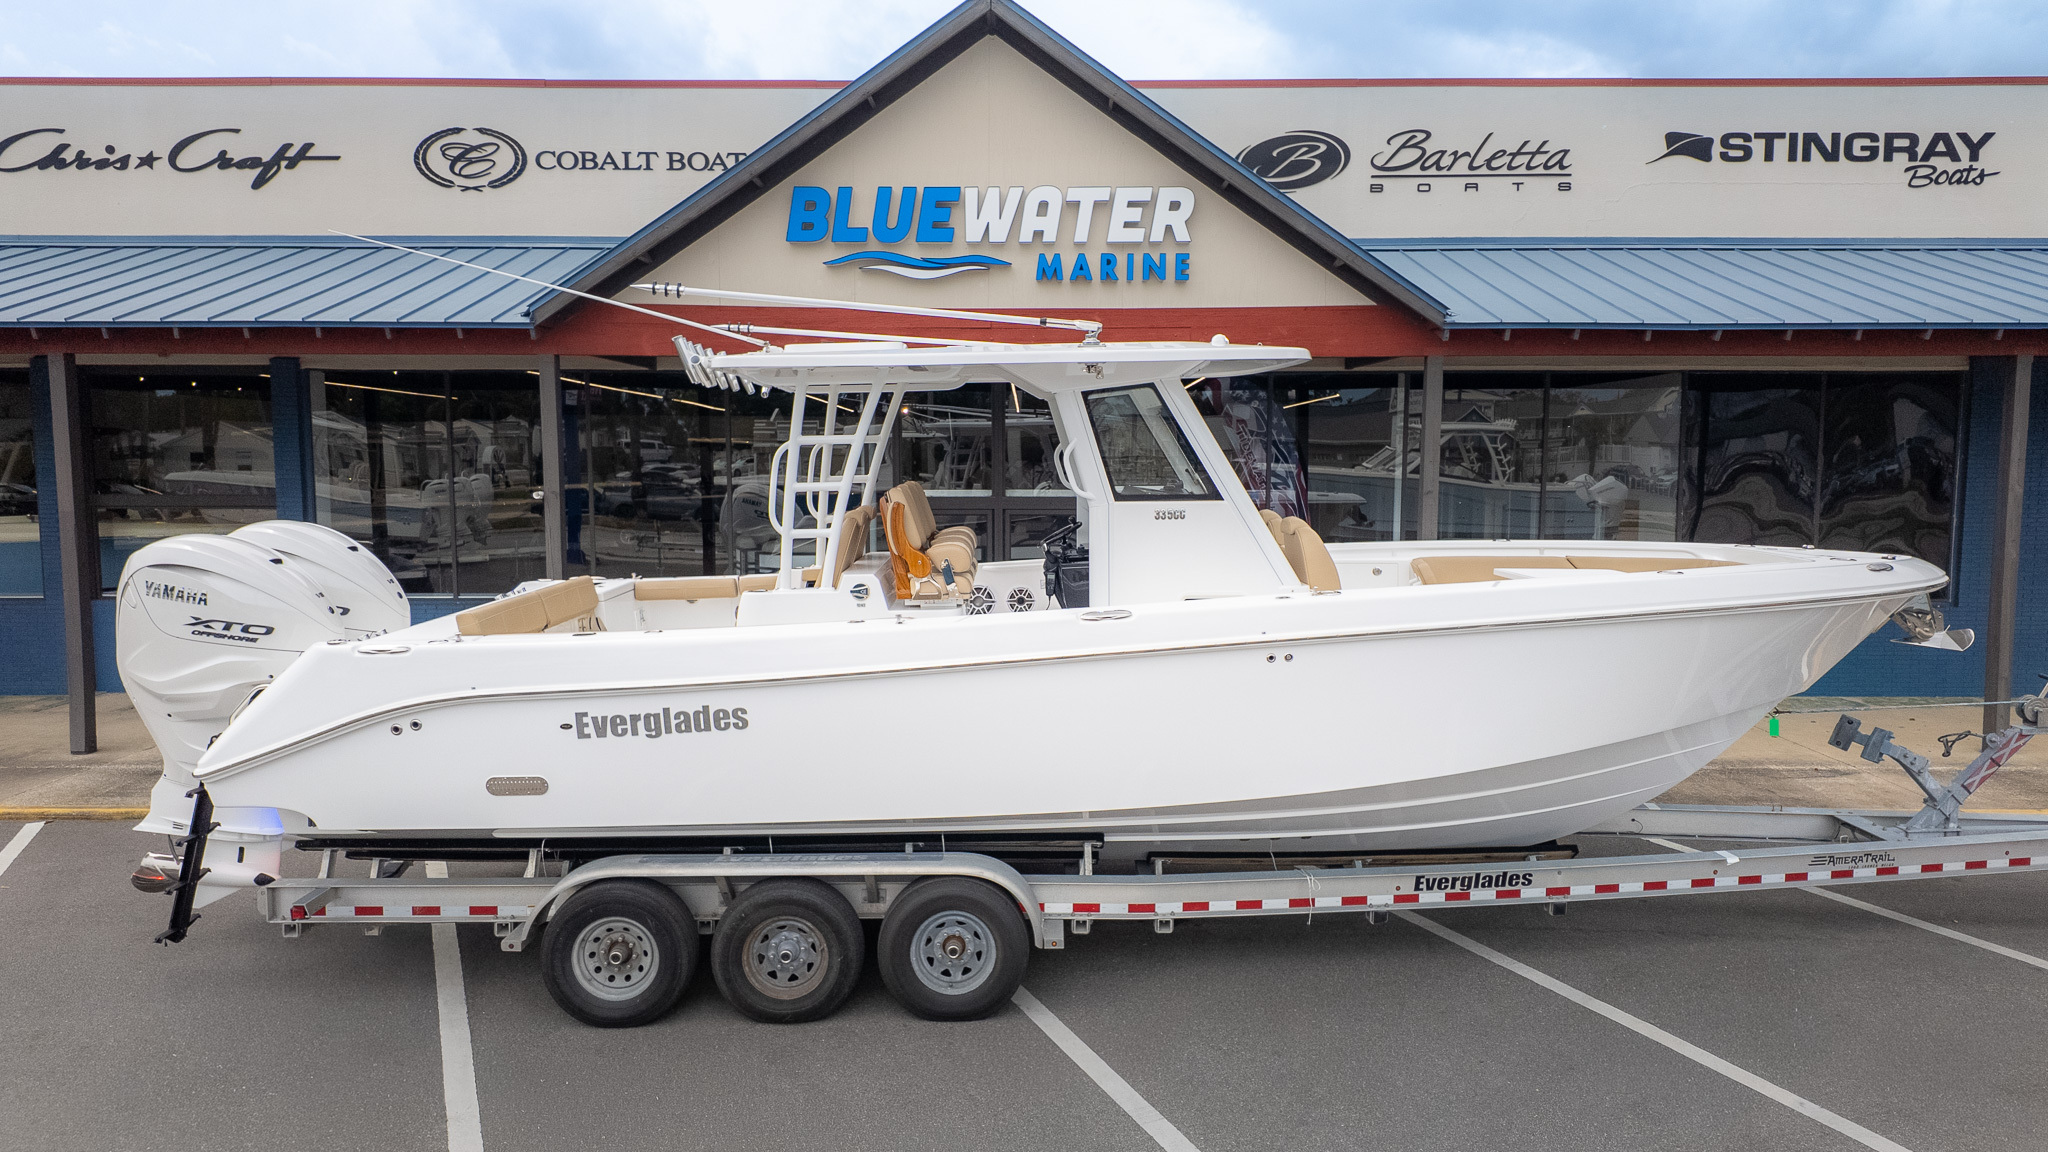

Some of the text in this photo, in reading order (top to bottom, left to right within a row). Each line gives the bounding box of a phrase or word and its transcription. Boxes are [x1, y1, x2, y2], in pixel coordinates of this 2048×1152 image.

[0, 128, 341, 190] Chris Craft
[1371, 128, 1573, 172] Barletta
[1719, 132, 1996, 163] STINGRAY
[535, 151, 750, 171] COBALT BOAT
[1370, 182, 1572, 193] BOATS
[1904, 164, 2001, 188] Boats
[1036, 252, 1190, 282] MARINE
[1154, 509, 1186, 520] 335CC
[145, 580, 208, 606] YAMAHA
[183, 615, 275, 636] XTO
[191, 629, 259, 643] OFFSHORE
[575, 704, 749, 739] Everglades
[1413, 871, 1534, 892] Everglades
